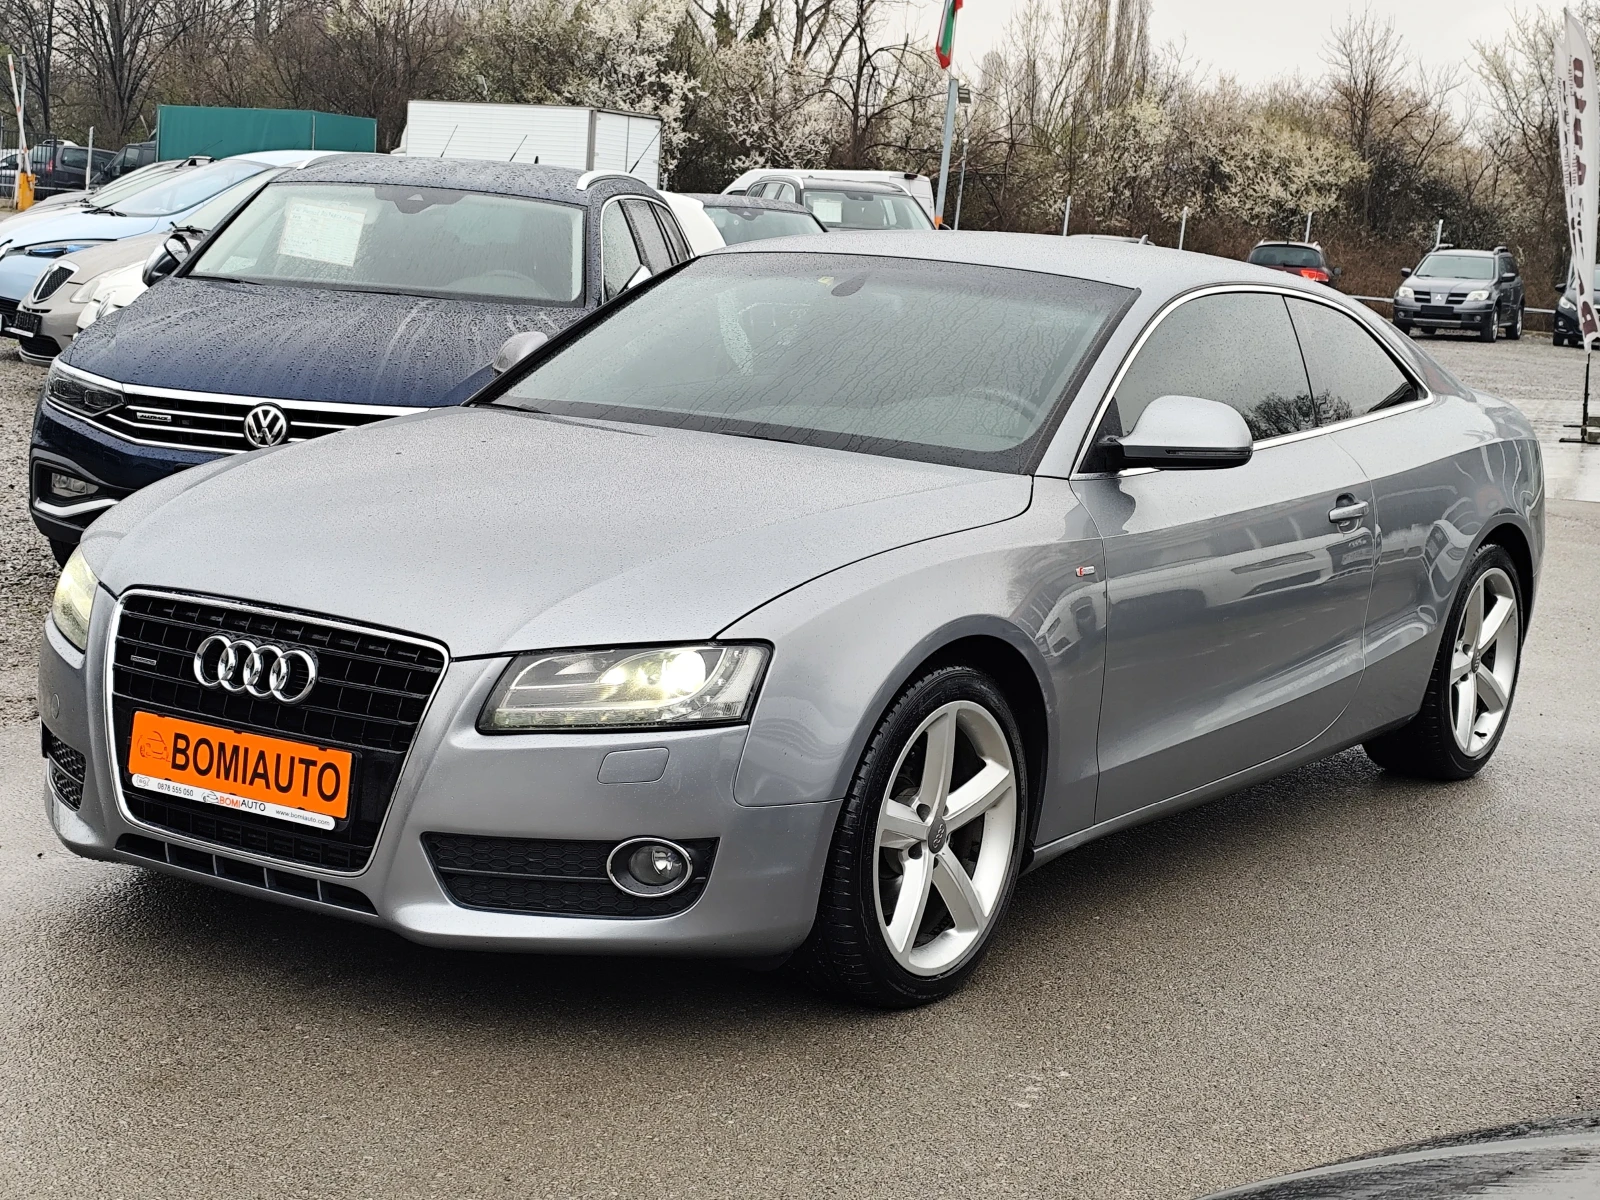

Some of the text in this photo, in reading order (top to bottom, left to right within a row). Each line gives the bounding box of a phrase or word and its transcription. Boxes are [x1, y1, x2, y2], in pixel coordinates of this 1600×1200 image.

[245, 406, 286, 447] VW
[171, 733, 341, 802] BOMIAUTO
[157, 782, 171, 791] 0878
[171, 785, 182, 795] 555
[183, 788, 194, 797] 050
[275, 809, 331, 826] www.bomiauto.com
